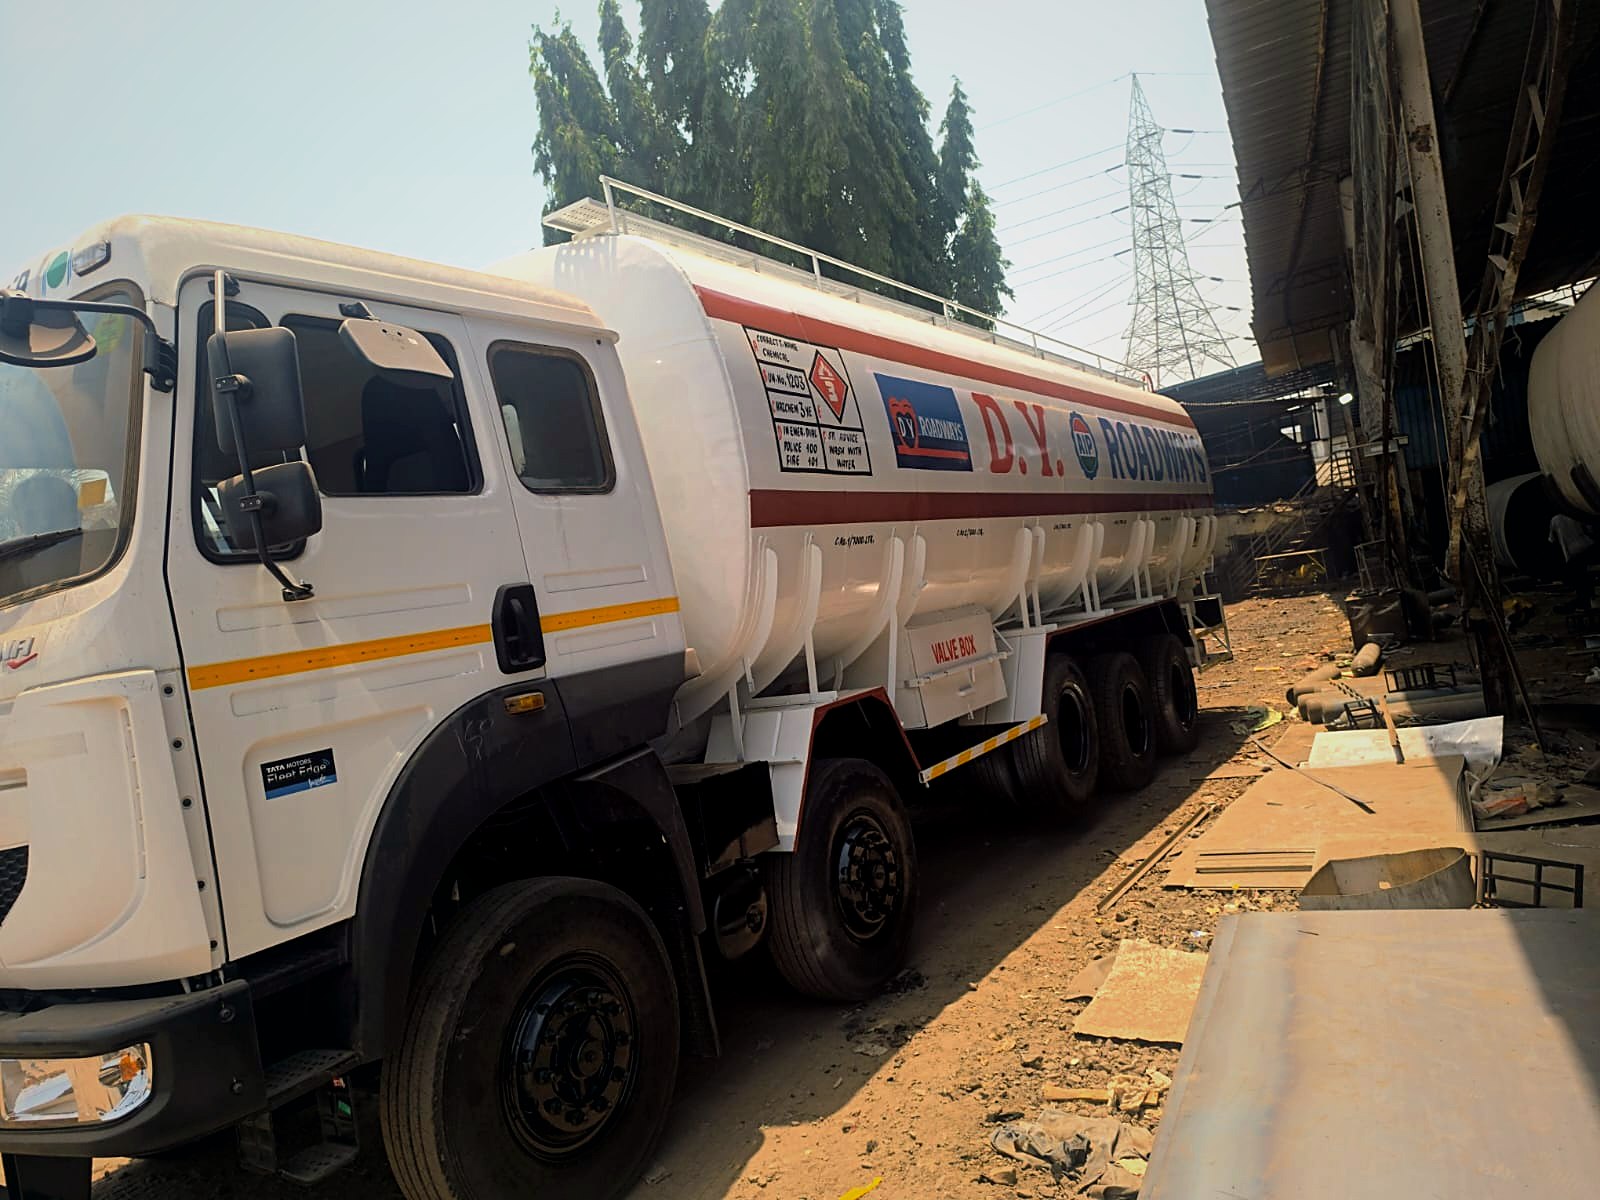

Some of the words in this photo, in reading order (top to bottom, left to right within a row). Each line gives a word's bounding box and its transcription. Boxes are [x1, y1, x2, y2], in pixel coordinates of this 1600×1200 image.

[762, 347, 790, 363] CHEMICAL
[786, 372, 806, 391] 1203
[918, 415, 964, 441] ROADWAYS
[783, 441, 802, 453] POLICE
[806, 443, 818, 454] 100
[829, 445, 845, 456] WASH
[847, 446, 862, 456] WITH
[1097, 416, 1208, 483] ROADWAYS
[786, 454, 800, 466] FIRE
[808, 456, 819, 467] 101
[836, 459, 856, 470] WATER
[931, 638, 960, 664] VALVE
[958, 634, 977, 657] BOX
[266, 765, 285, 774] TATA
[286, 758, 312, 769] MOTORS
[299, 763, 327, 776] Edge
